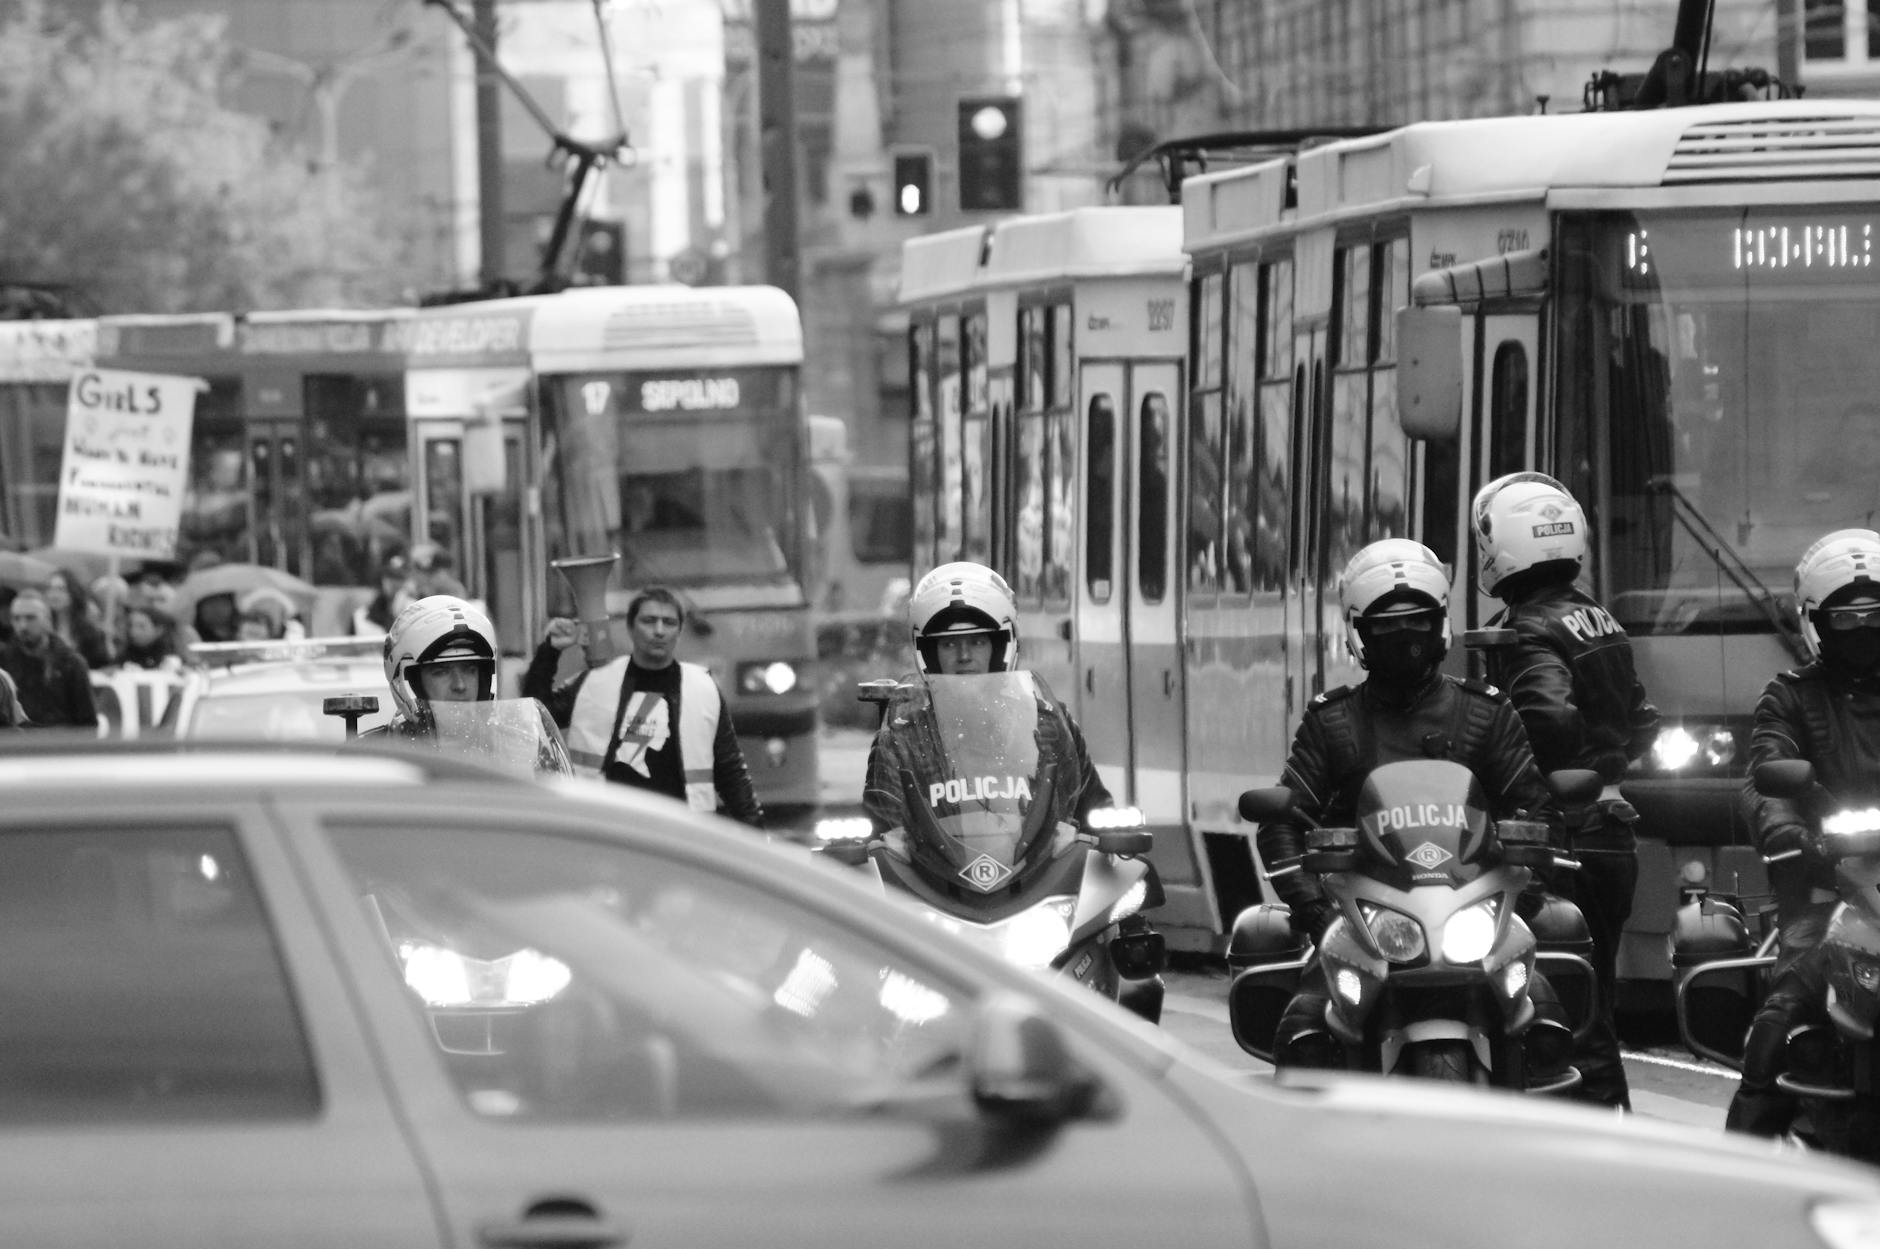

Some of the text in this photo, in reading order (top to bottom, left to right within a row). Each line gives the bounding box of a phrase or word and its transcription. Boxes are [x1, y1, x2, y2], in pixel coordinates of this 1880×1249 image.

[581, 381, 611, 415] 17
[1536, 522, 1574, 537] POLICJA
[929, 776, 1032, 808] POLICJA
[1377, 804, 1469, 836] POLICJA
[1412, 872, 1449, 881] HONDA
